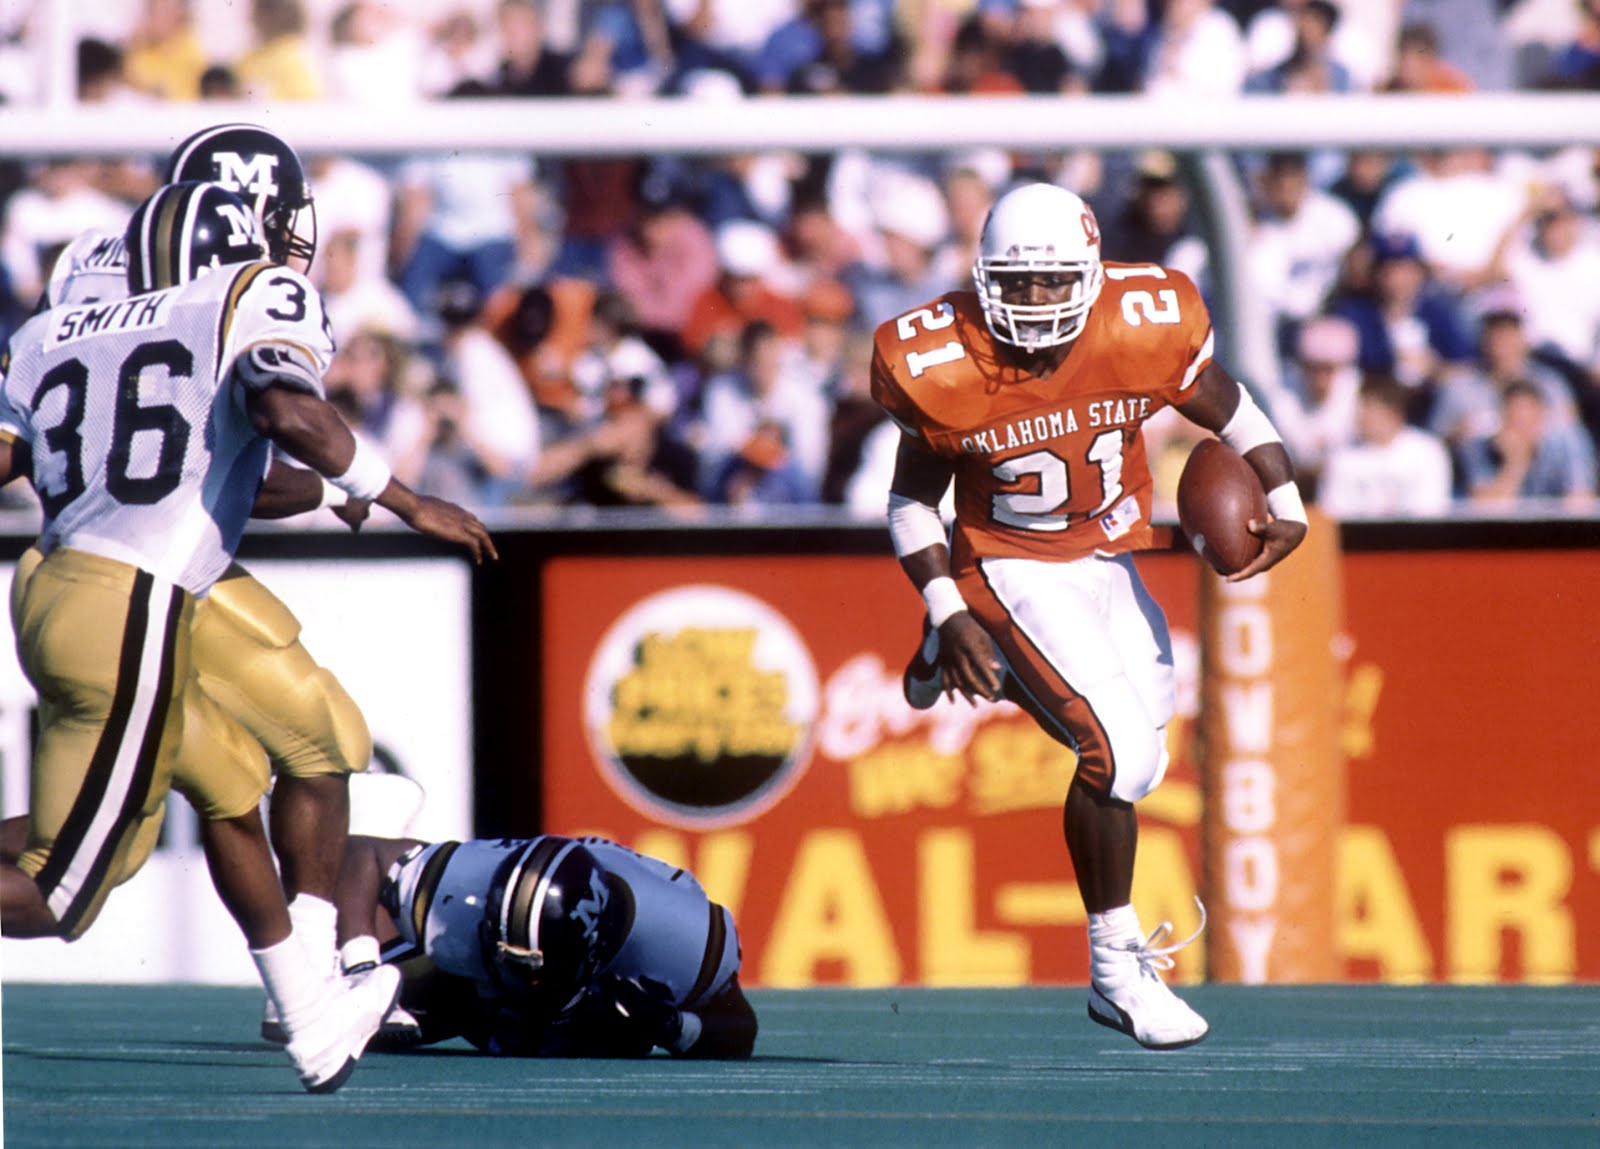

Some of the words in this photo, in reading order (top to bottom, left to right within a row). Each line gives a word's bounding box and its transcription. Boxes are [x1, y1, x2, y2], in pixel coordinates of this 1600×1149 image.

[211, 151, 279, 197] M
[84, 237, 128, 269] MIL
[215, 203, 264, 248] M
[57, 294, 168, 342] SMITH
[1104, 266, 1181, 327] 21
[896, 301, 966, 379] 21
[30, 339, 194, 521] 36
[961, 408, 1079, 454] OKLAHOMA
[1088, 397, 1152, 427] STATE
[991, 428, 1124, 533] 21
[1216, 574, 1280, 985] OWBOY
